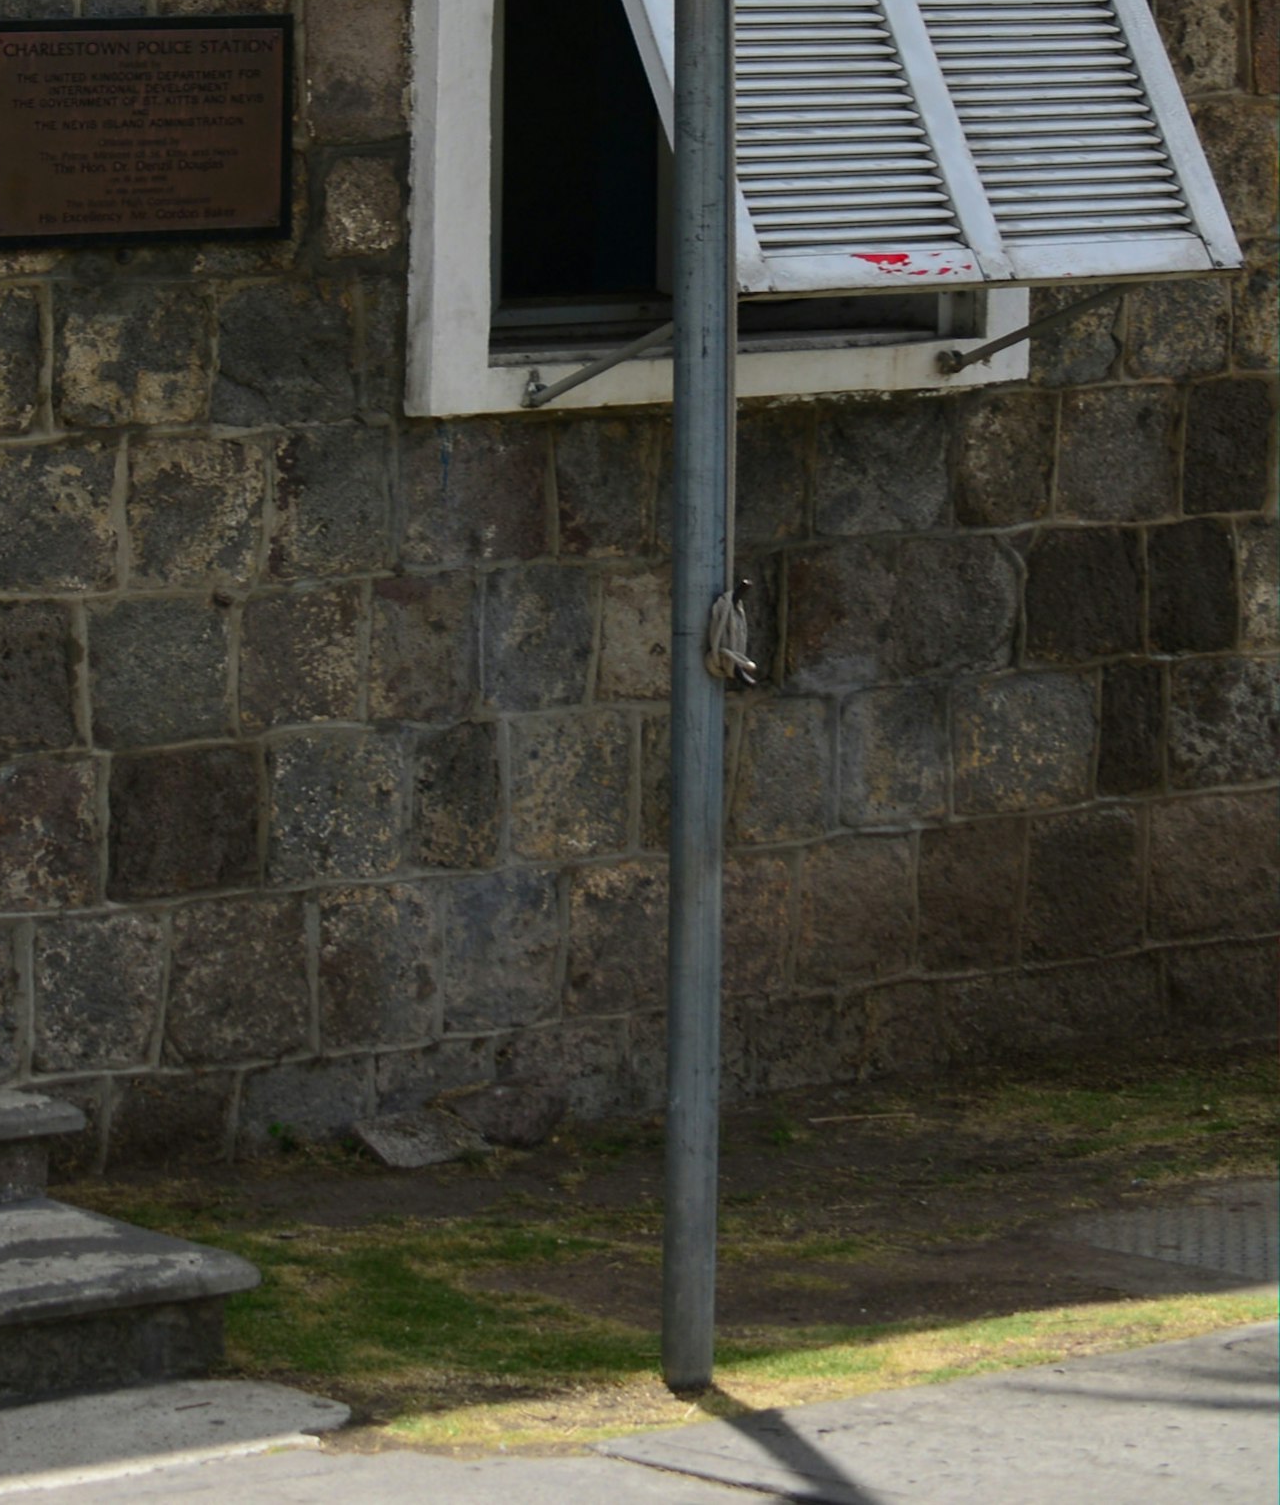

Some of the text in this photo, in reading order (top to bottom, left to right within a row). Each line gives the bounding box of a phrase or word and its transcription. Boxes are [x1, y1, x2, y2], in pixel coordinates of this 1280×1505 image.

[4, 39, 272, 57] CHARLESTOWN POLICE STATION
[17, 73, 39, 83] THE
[44, 72, 87, 83] UNITED
[157, 70, 232, 81] DEPARTMENT
[238, 69, 260, 79] FOR
[49, 82, 230, 95] INTERNATIONAL DEVELOPMENT
[12, 99, 34, 109] THE
[39, 97, 117, 108] GOVERNMENT
[123, 96, 137, 106] OF
[165, 95, 199, 105] KITTS
[204, 95, 226, 103] AND
[231, 93, 264, 103] NEVIS
[35, 117, 244, 130] THE NEVIS ISLAND ADMINISTRATION
[52, 162, 76, 173] The
[136, 159, 173, 172] Denzil
[177, 158, 224, 172] Douglas
[38, 213, 56, 223] His
[62, 211, 122, 223] Excellency
[155, 209, 199, 220] Gordon
[204, 207, 236, 217] Baker
